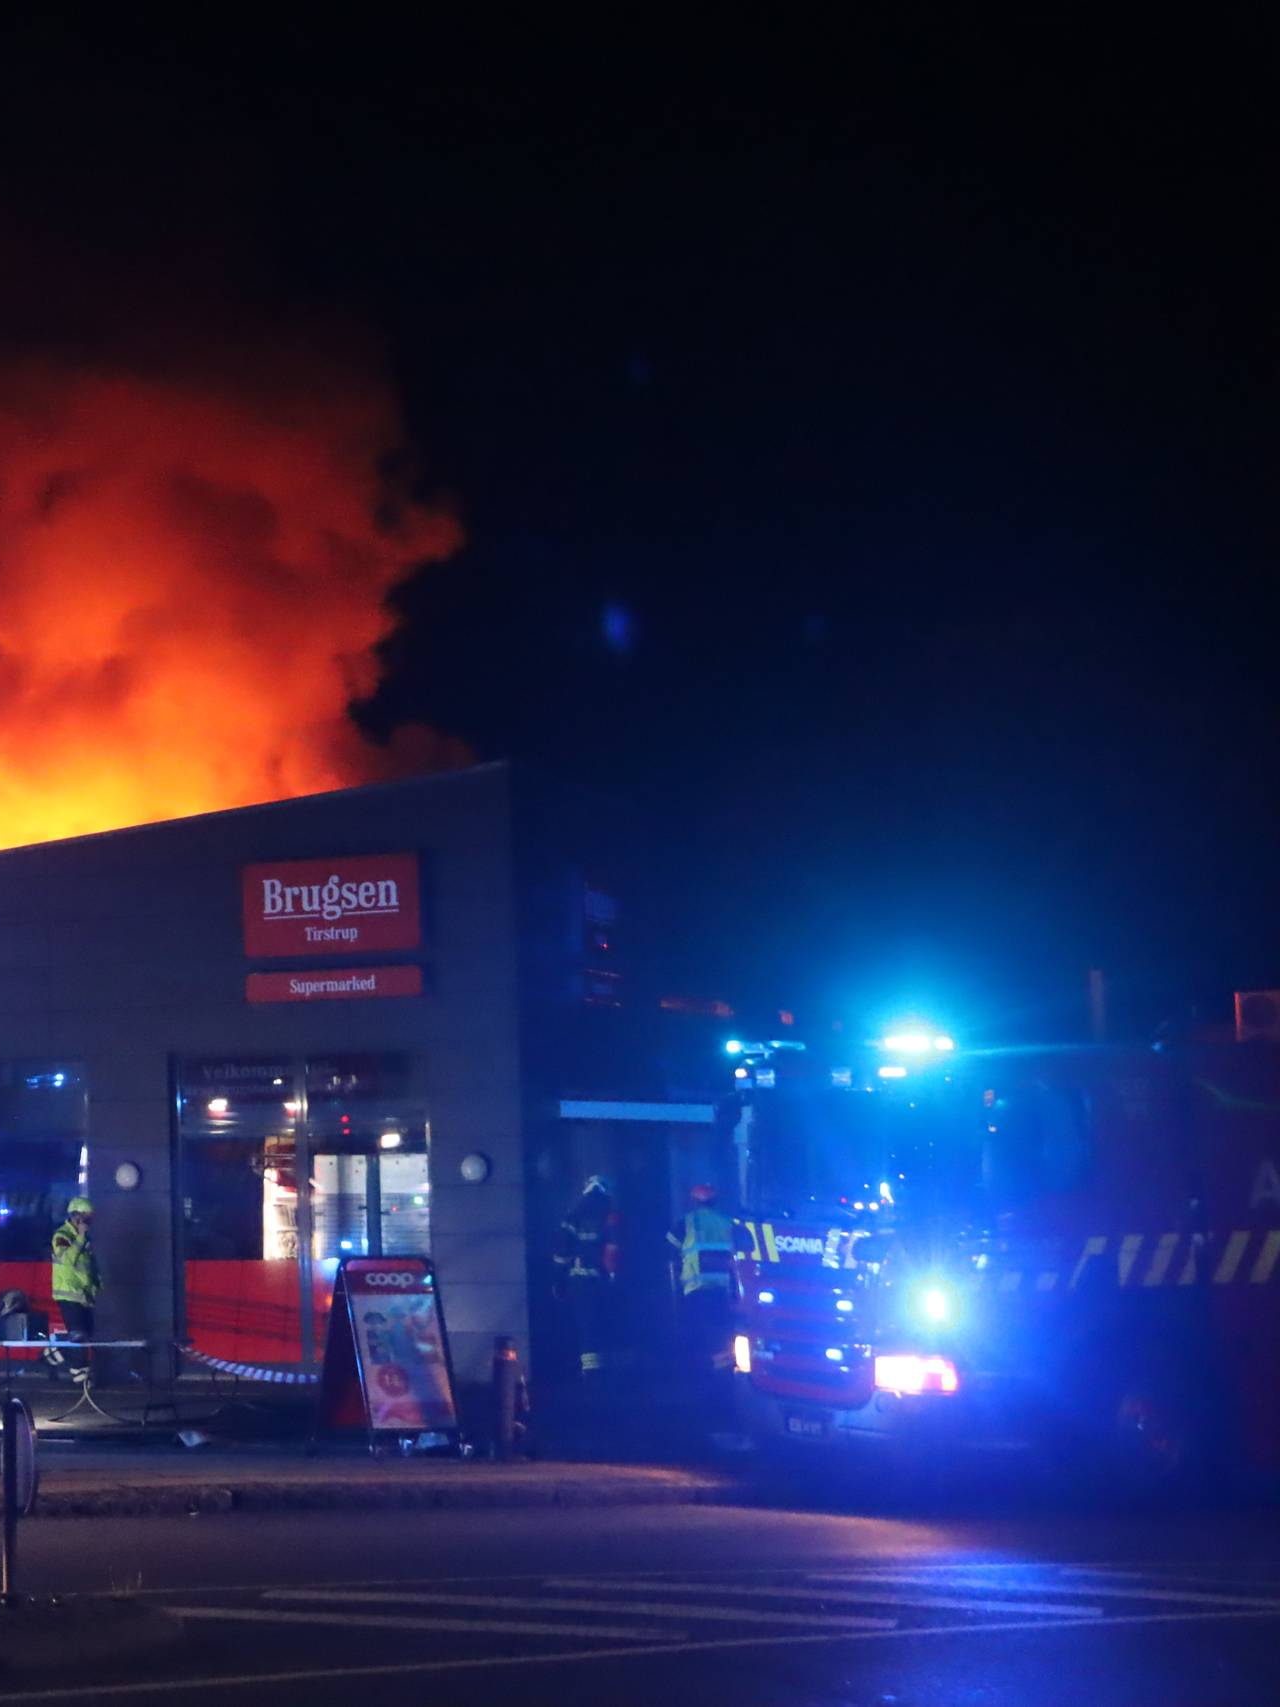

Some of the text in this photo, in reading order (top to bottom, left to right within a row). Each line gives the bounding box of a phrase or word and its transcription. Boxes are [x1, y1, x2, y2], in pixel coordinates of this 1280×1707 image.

[263, 875, 399, 920] Brugsen
[305, 926, 358, 942] Tirstrup
[289, 975, 376, 996] Supermarked
[775, 1236, 823, 1254] SCANIA
[365, 1272, 414, 1288] coop
